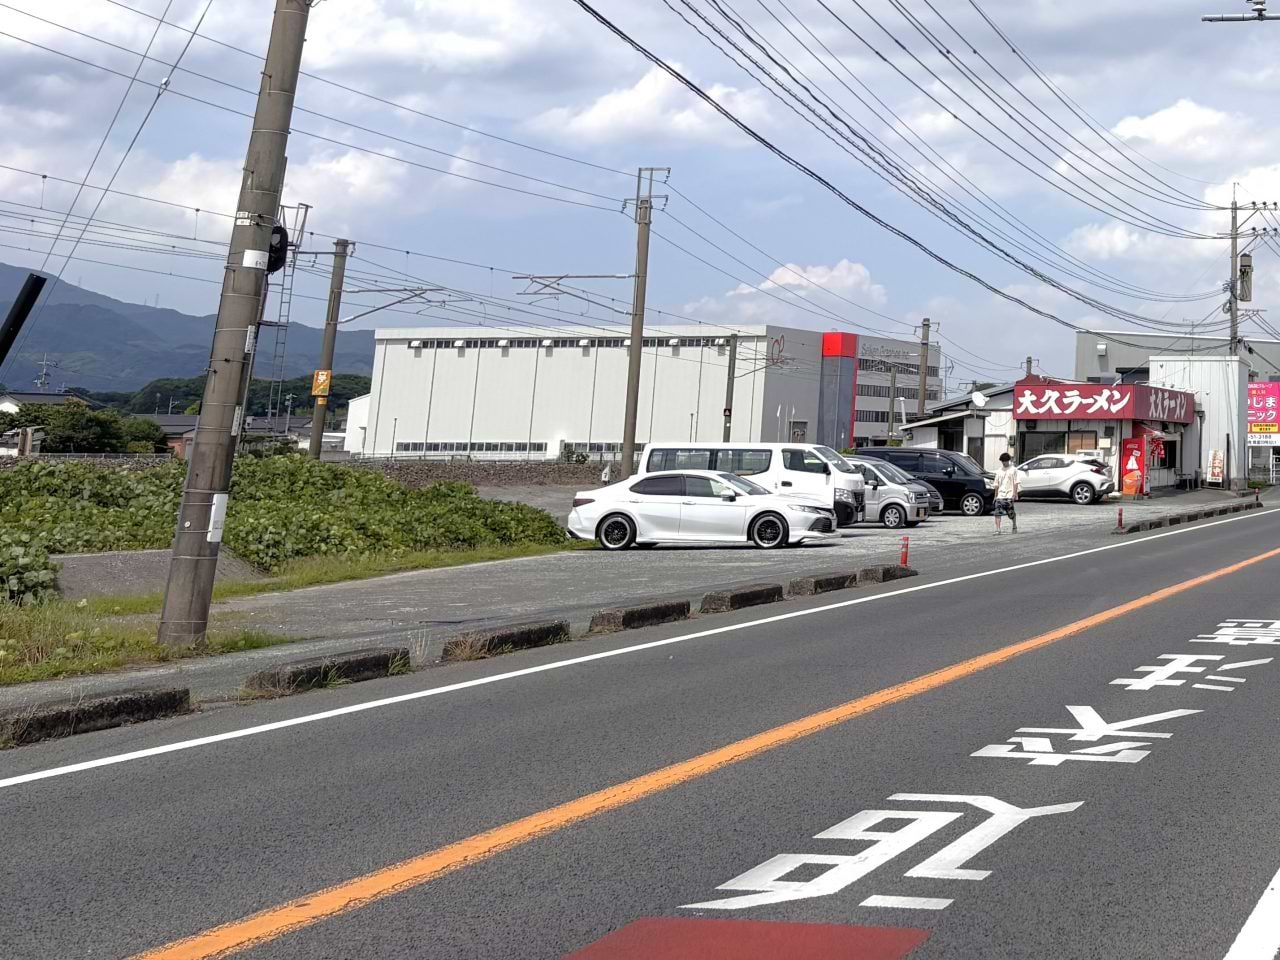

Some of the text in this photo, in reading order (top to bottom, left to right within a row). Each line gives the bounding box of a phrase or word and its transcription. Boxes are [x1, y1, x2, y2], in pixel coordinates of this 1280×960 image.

[1016, 389, 1131, 414] 大久ラーメン
[1150, 389, 1187, 419] 大久ラーメン
[1248, 396, 1276, 408] じま
